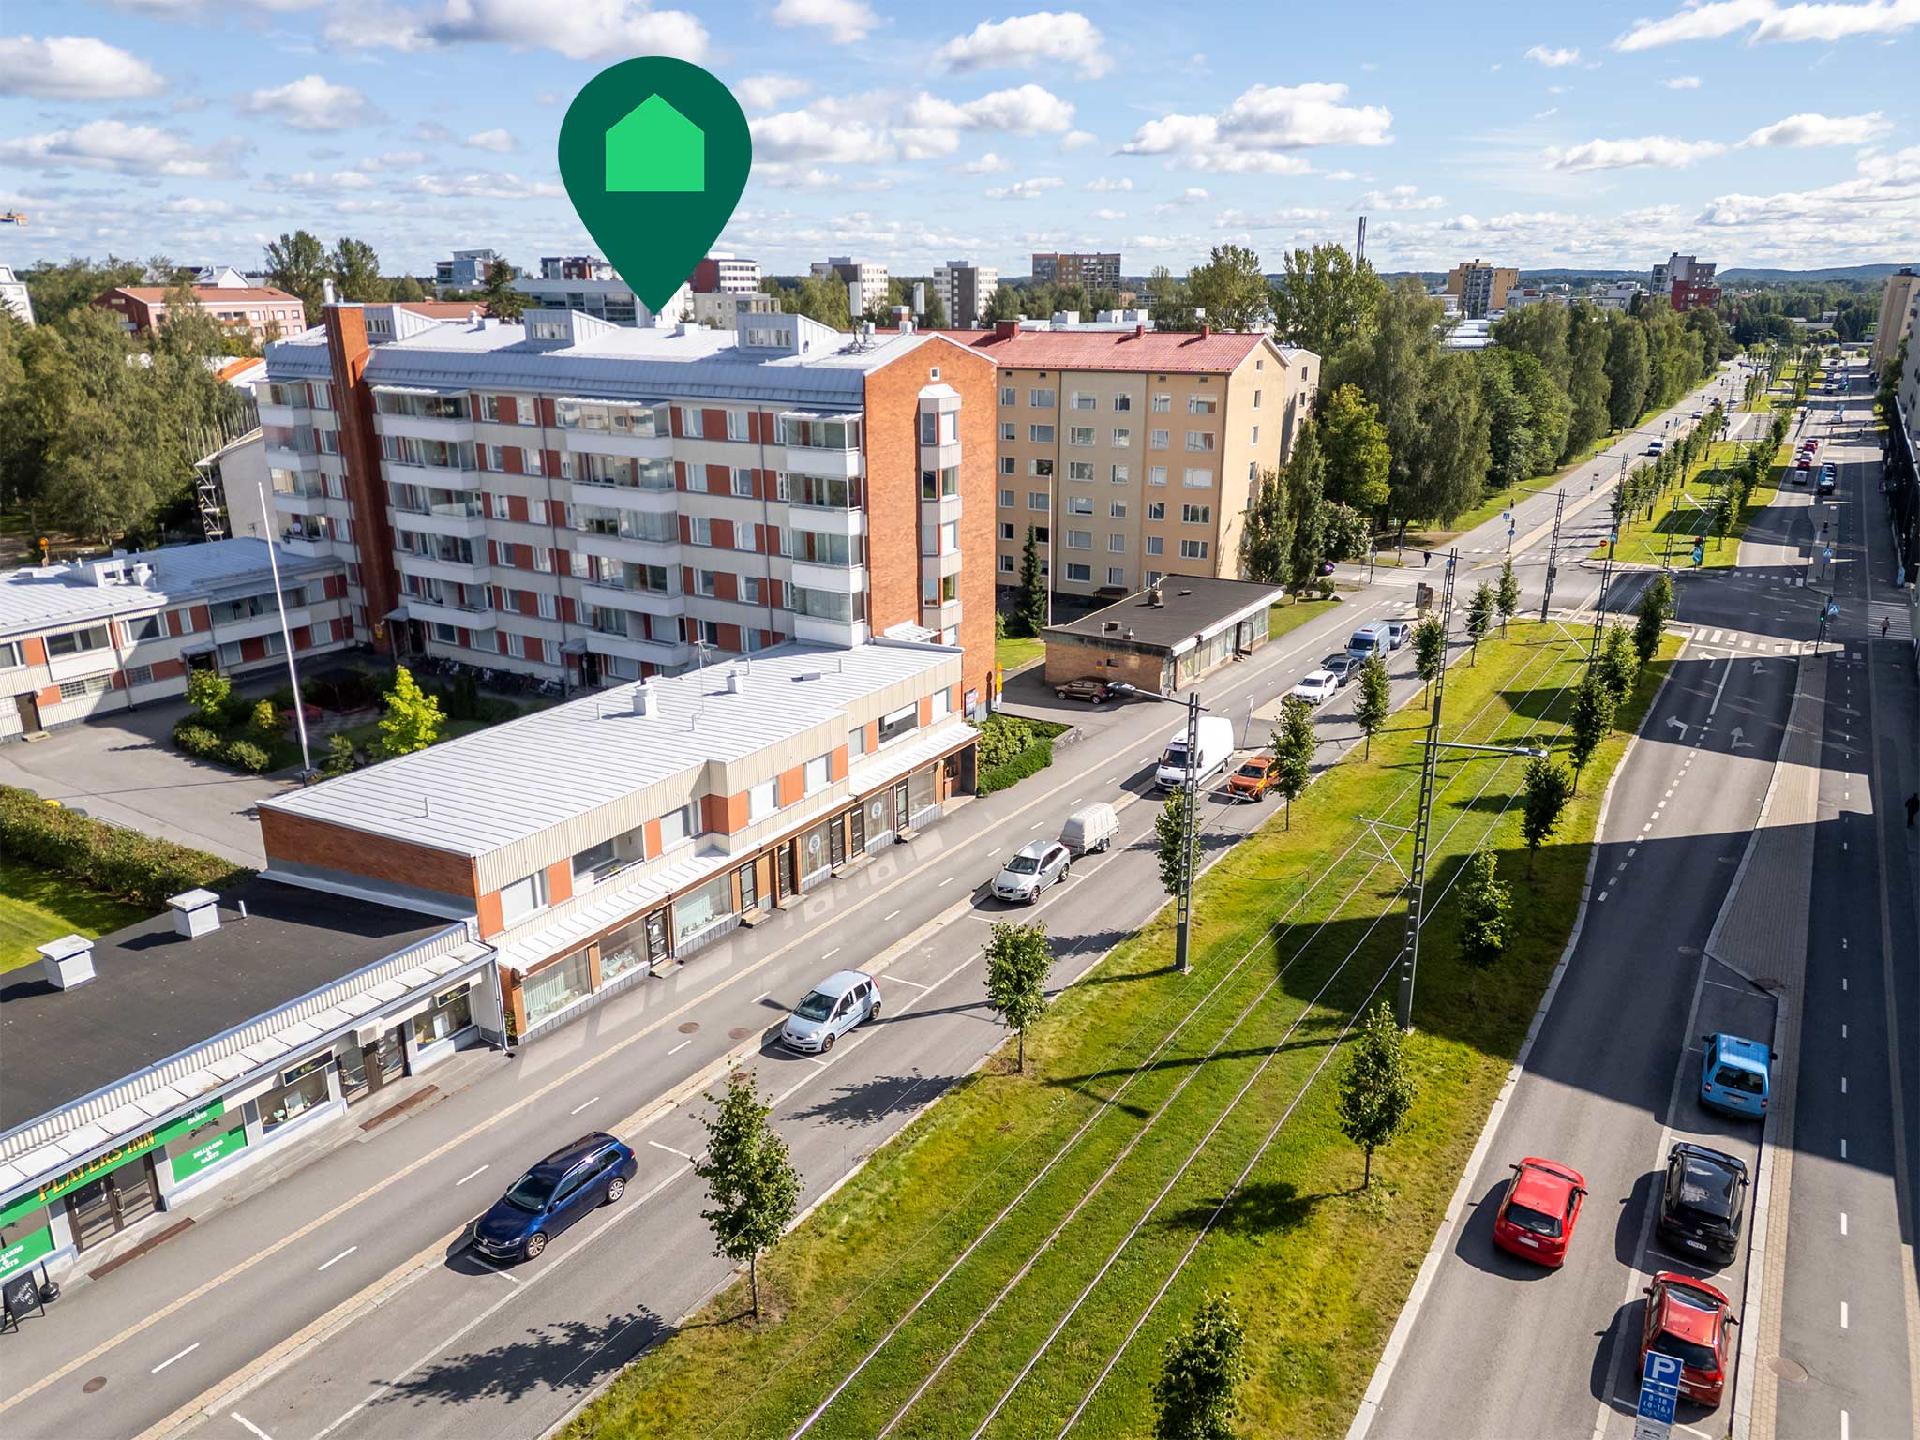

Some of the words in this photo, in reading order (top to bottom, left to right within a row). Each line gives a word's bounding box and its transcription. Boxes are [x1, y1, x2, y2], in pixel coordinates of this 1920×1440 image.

[38, 1147, 124, 1202] PLAYERS
[127, 1130, 156, 1154] INN
[1652, 1356, 1676, 1379] P
